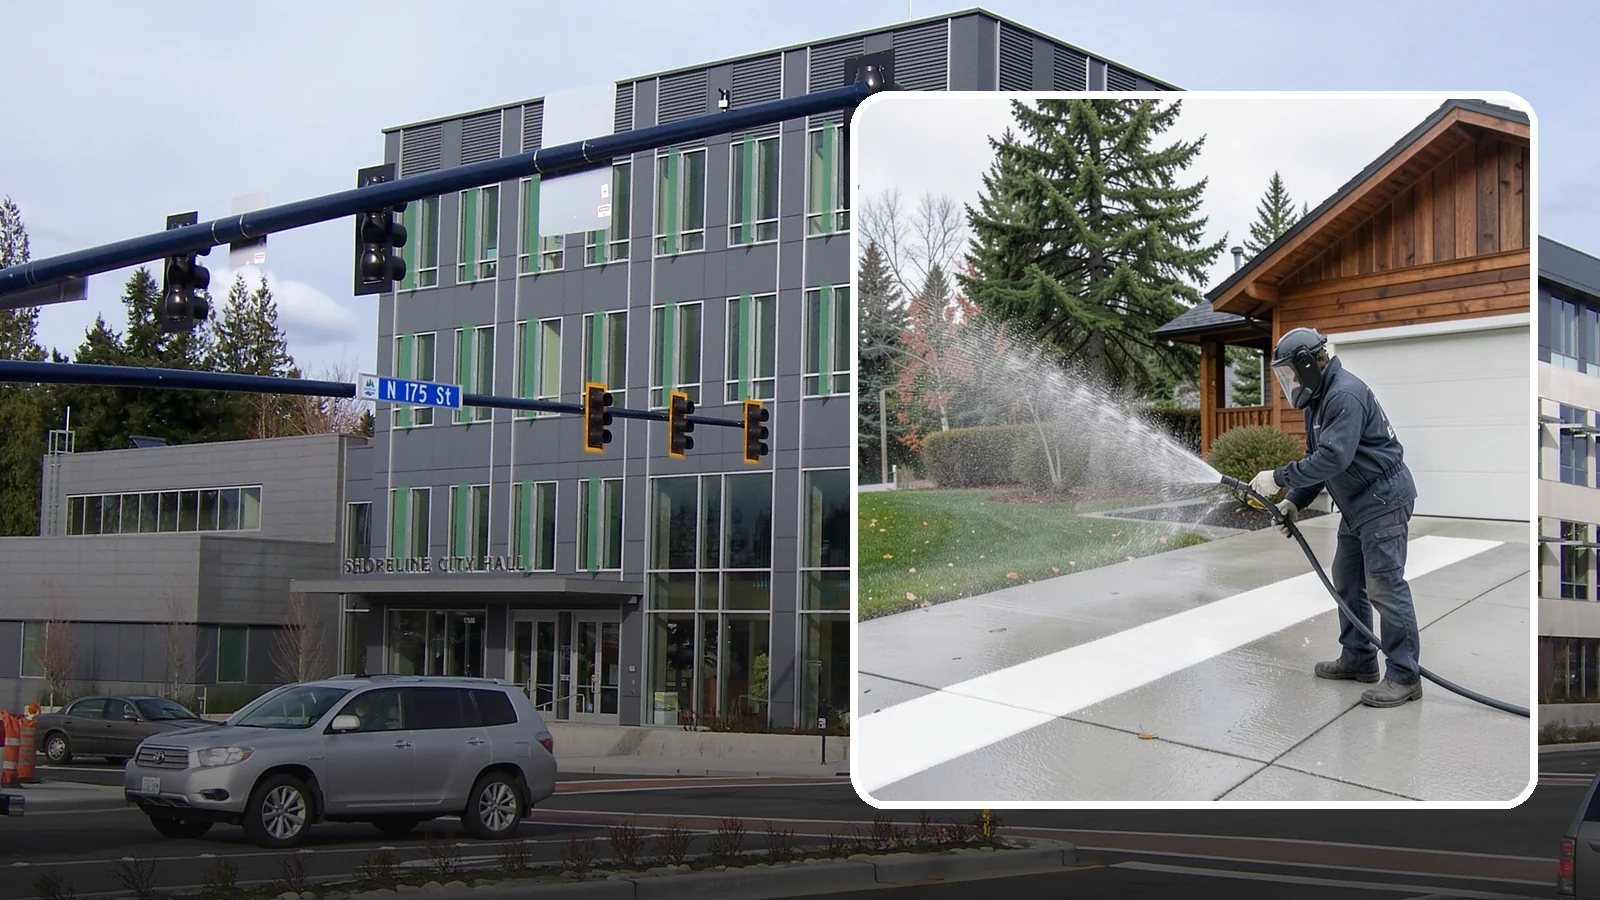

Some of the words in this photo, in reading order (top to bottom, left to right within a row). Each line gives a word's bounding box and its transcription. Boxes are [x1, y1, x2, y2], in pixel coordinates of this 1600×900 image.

[387, 380, 396, 399] N
[405, 383, 427, 403] 175
[436, 386, 451, 405] St
[343, 557, 432, 574] SHORELINE
[438, 556, 476, 572] CITY
[484, 556, 525, 571] HALL
